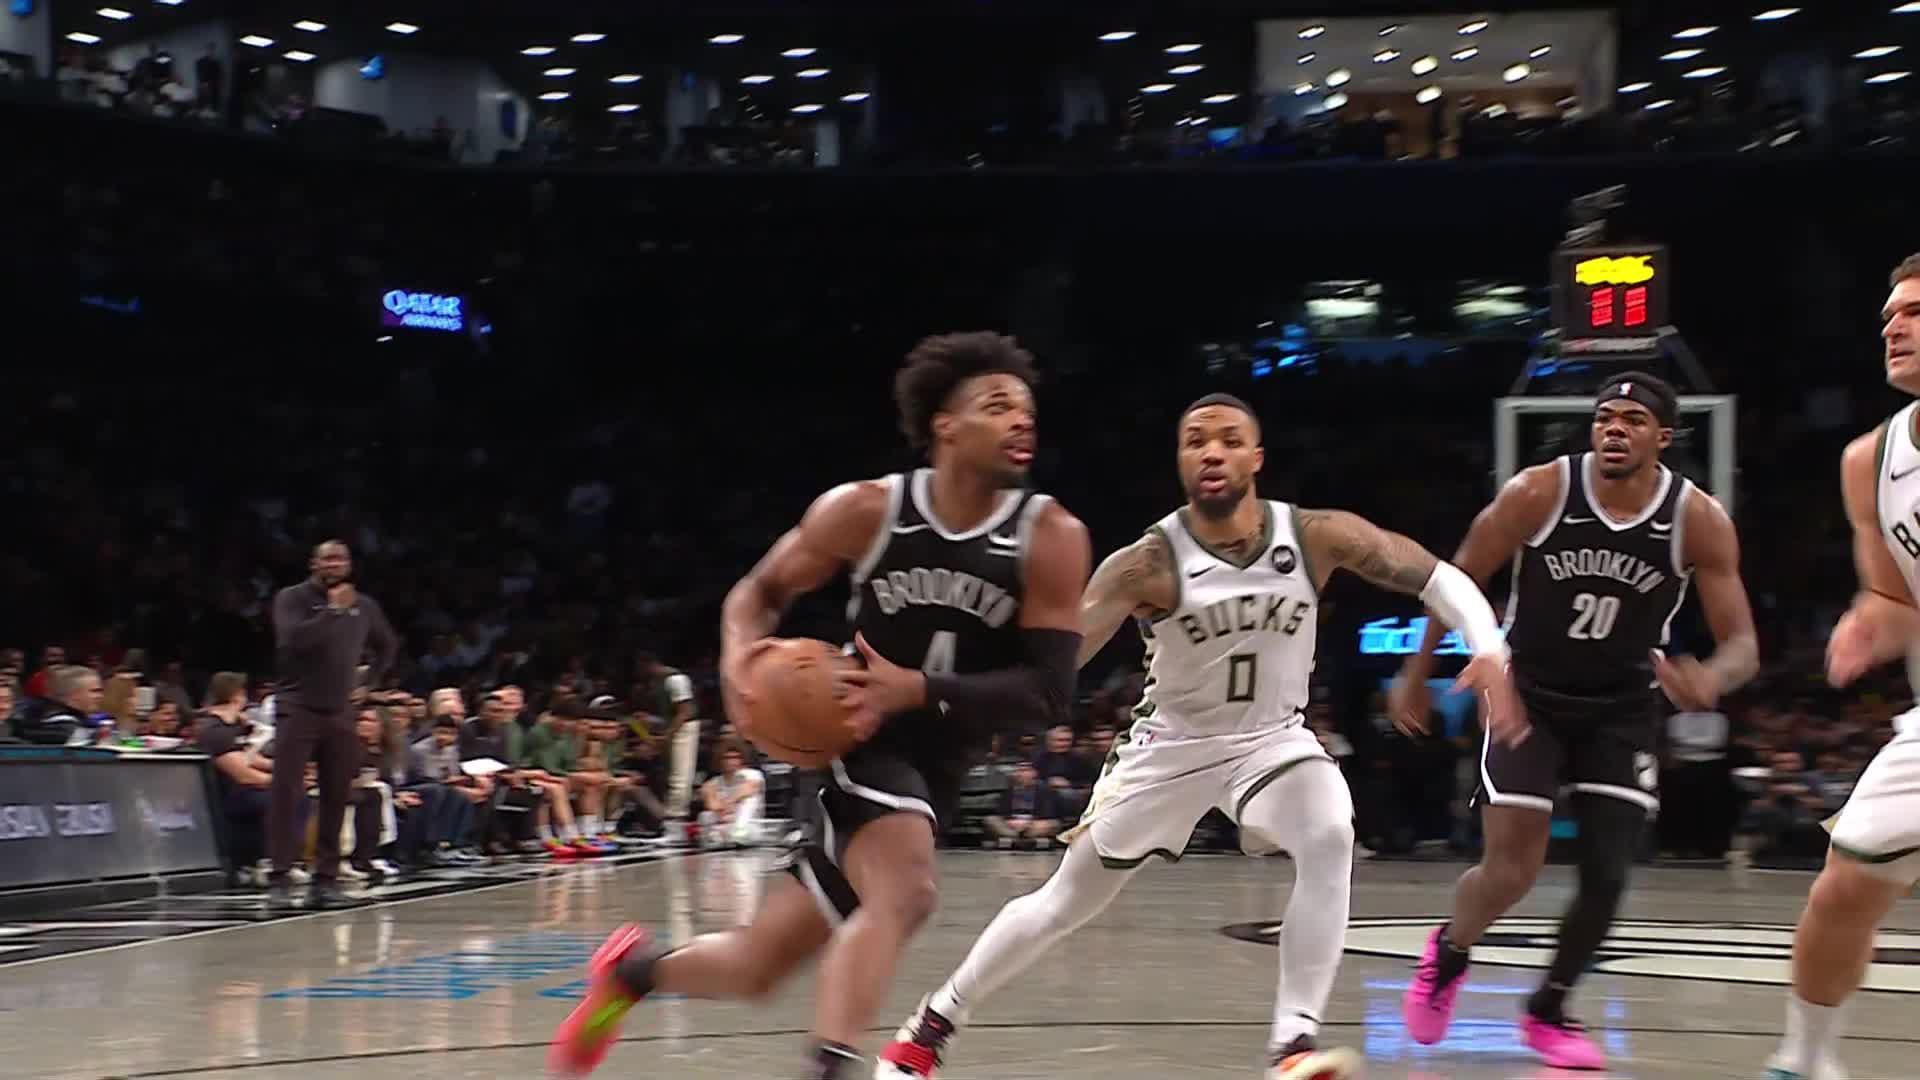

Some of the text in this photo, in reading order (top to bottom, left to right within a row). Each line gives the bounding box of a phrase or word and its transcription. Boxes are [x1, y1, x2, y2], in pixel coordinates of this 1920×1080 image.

[1545, 549, 1665, 594] BROOKLYN
[872, 567, 1016, 628] BROOKLYN
[1179, 595, 1310, 644] BUCKS
[1568, 593, 1620, 641] 20
[1227, 653, 1257, 702] 0
